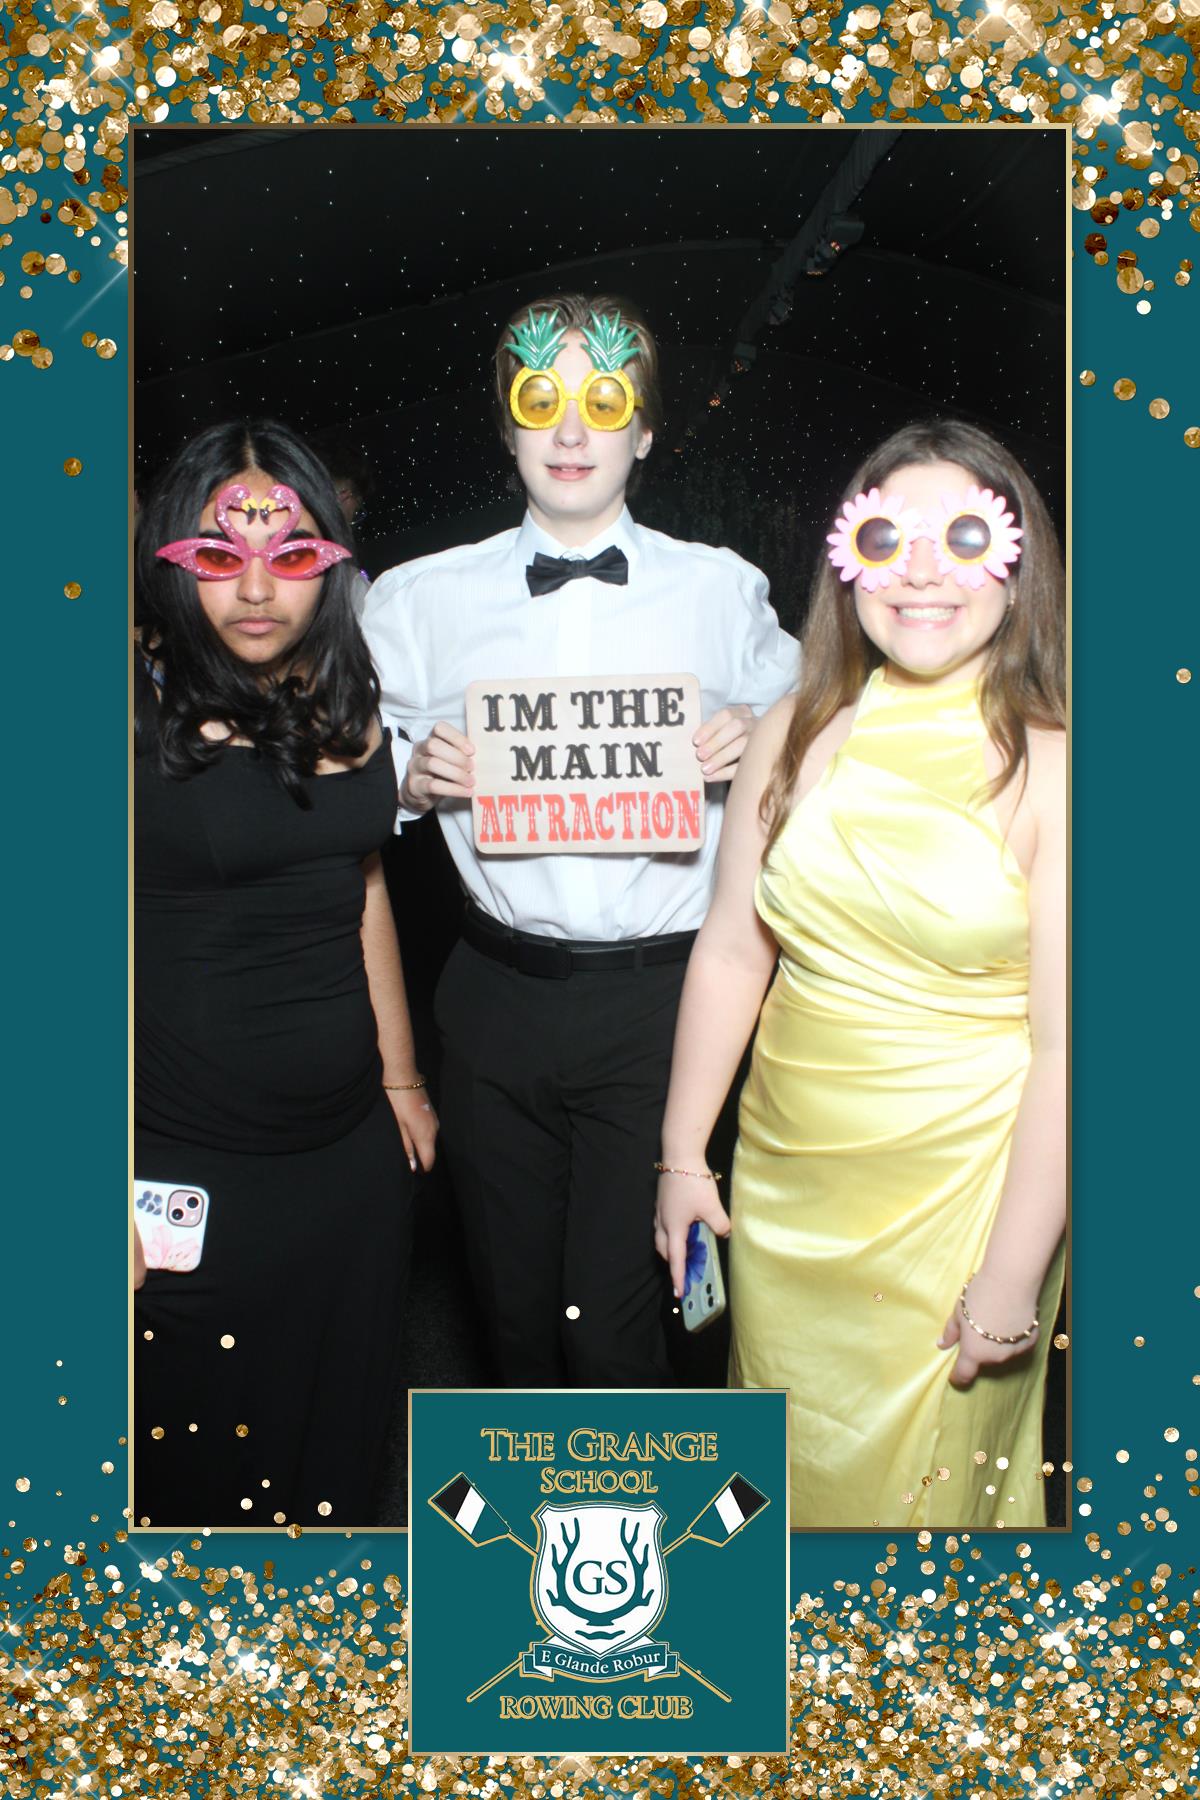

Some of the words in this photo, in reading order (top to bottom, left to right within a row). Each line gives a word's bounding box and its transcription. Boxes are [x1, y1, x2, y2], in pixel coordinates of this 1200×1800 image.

[482, 692, 558, 732] IM
[570, 687, 686, 730] THE
[509, 741, 663, 781] MAIN
[477, 790, 700, 842] ATTRACTION
